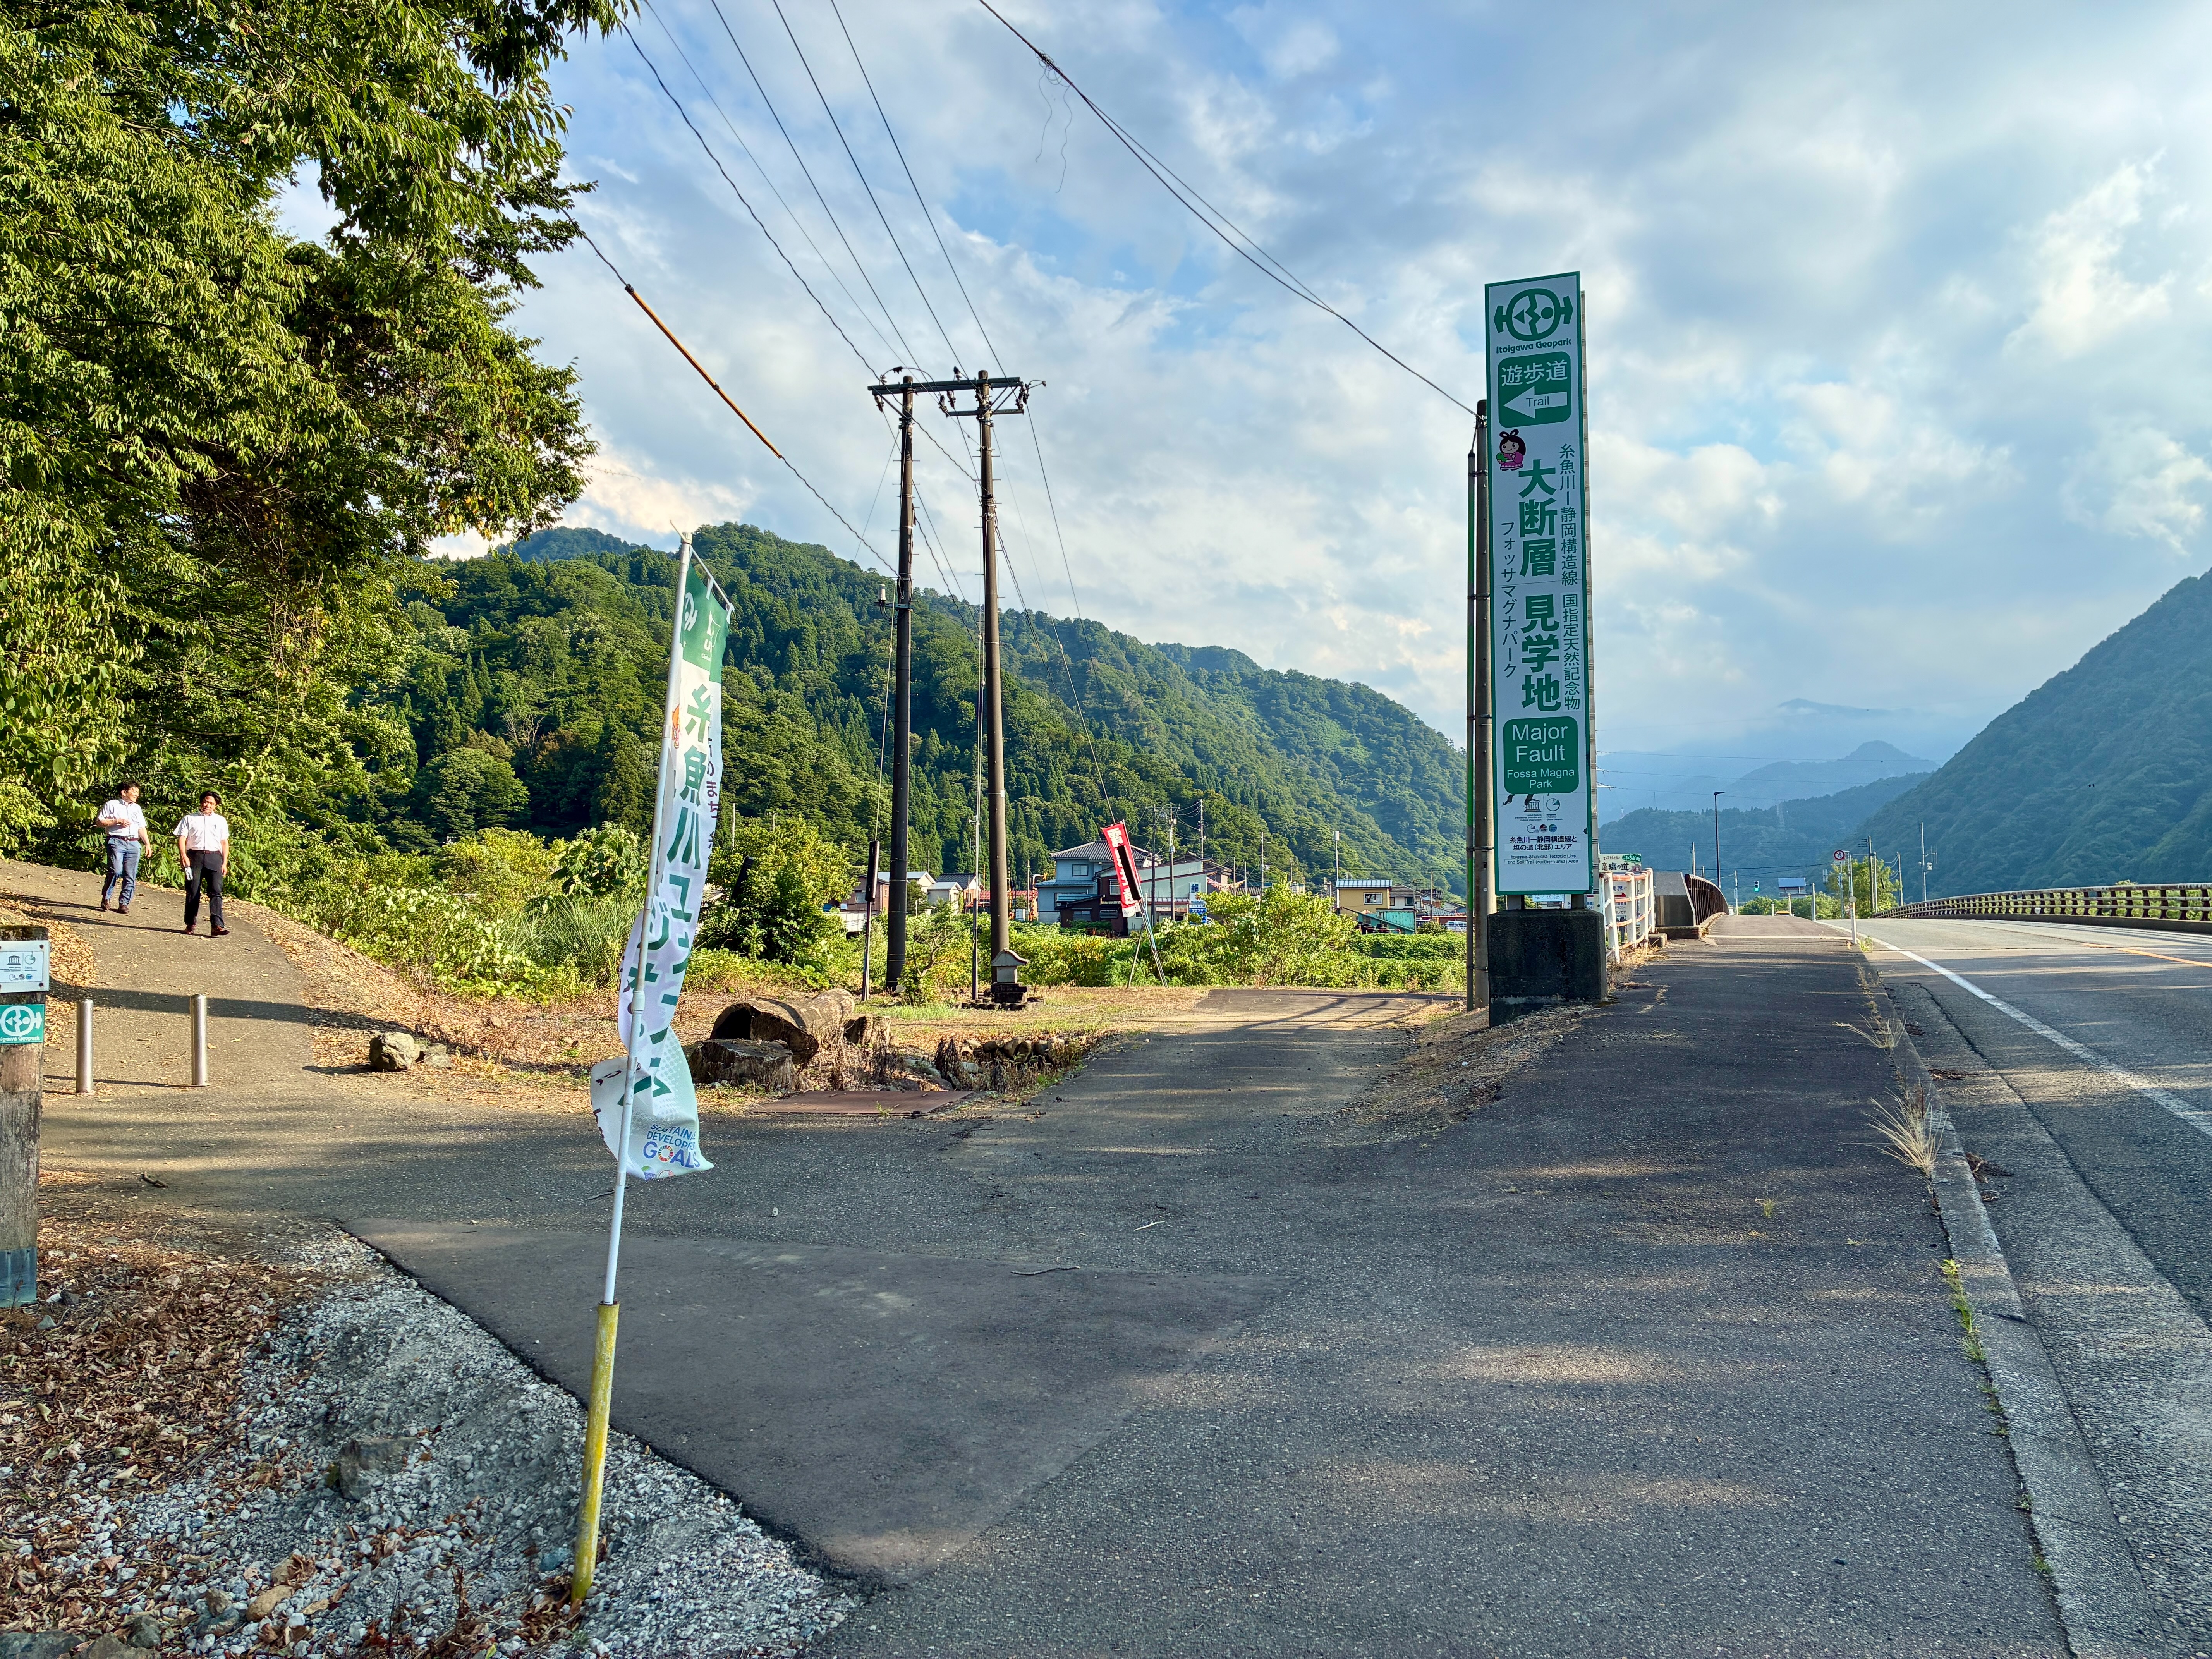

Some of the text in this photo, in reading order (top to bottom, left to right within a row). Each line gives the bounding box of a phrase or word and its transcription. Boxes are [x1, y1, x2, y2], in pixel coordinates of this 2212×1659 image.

[1496, 338, 1571, 354] Itoigawa Geopark
[1501, 359, 1568, 387] 遊歩道
[1526, 396, 1549, 407] Trail
[1518, 459, 1561, 712] 大断層 見学地
[1501, 522, 1517, 678] フォッサマグナパーク
[1563, 594, 1580, 710] 国指定天然記念物
[1513, 723, 1568, 744] Major
[1516, 745, 1565, 763] Fault
[1507, 768, 1575, 779] Fossa Magna
[1530, 780, 1553, 788] Park
